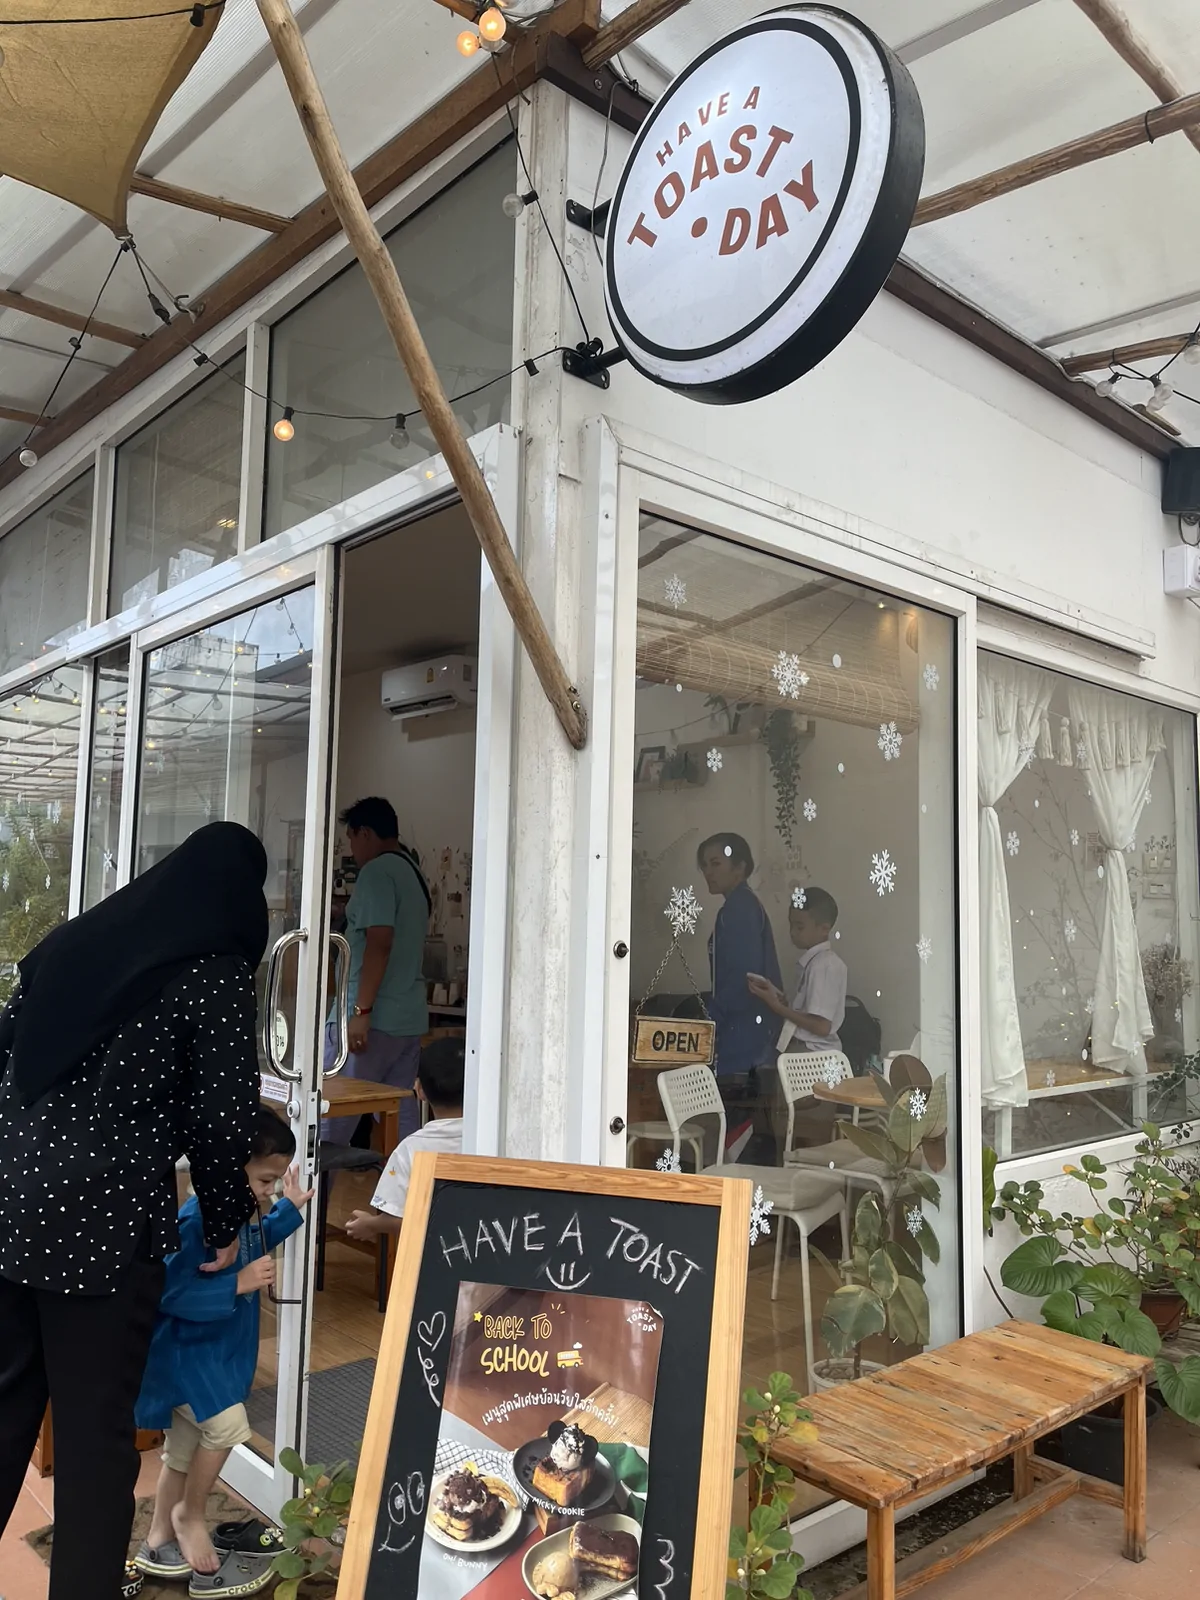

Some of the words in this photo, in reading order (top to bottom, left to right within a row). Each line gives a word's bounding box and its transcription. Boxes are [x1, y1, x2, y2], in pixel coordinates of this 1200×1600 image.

[655, 91, 730, 167] HAVE
[742, 85, 761, 110] A
[626, 124, 794, 248] TOAST
[718, 159, 820, 256] DAY
[651, 1029, 700, 1053] OPEN
[439, 1212, 546, 1267] HAVE
[556, 1212, 584, 1256] A
[606, 1216, 704, 1294] TOAST
[484, 1314, 526, 1340] BACK
[530, 1312, 553, 1340] TO
[626, 1312, 654, 1324] TOAST
[642, 1323, 657, 1332] DAY
[480, 1343, 550, 1377] SCHOOL
[532, 1496, 556, 1514] MICKY
[557, 1506, 585, 1516] COOKIE
[457, 1557, 488, 1571] BUNNY
[228, 1578, 263, 1596] crocs
